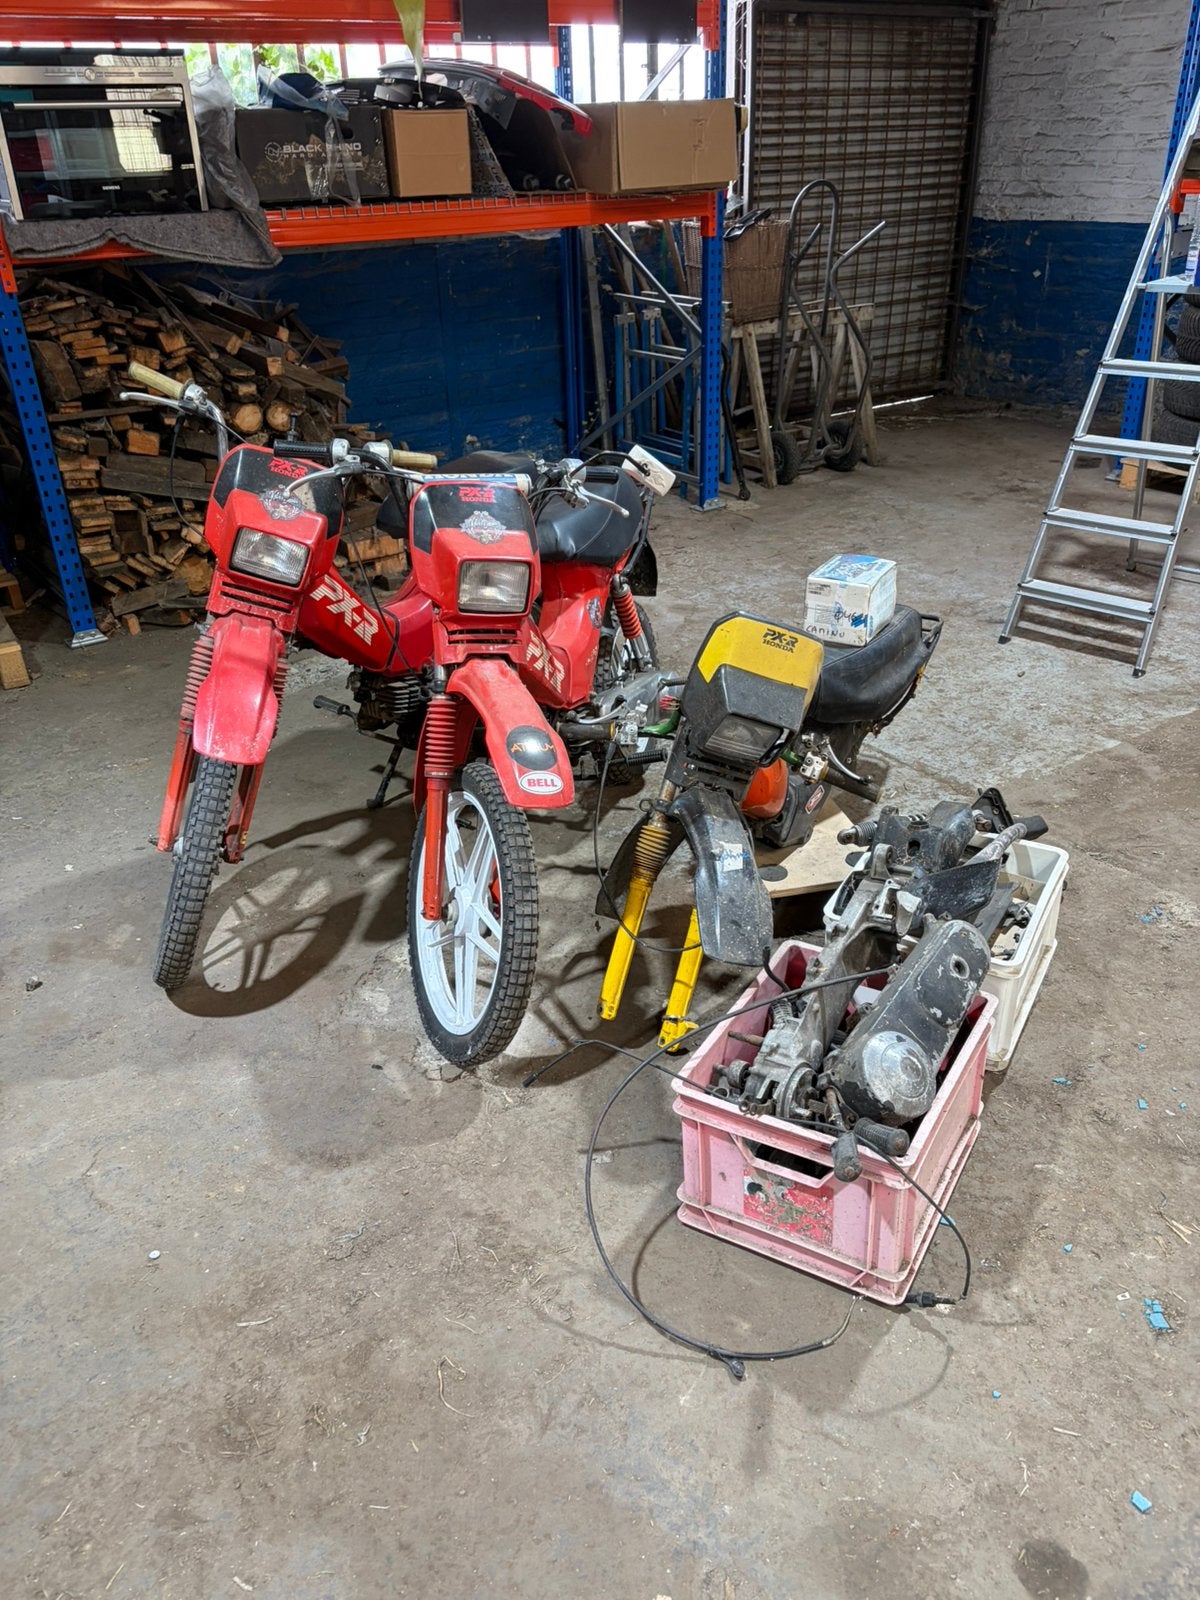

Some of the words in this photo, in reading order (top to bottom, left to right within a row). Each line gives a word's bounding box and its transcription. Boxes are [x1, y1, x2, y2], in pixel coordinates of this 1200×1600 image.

[283, 144, 322, 153] BLACK
[310, 574, 379, 646] PX-R
[762, 638, 794, 653] HONDA
[763, 627, 799, 648] PX-R
[526, 630, 565, 694] PX-R
[527, 778, 558, 788] BELL
